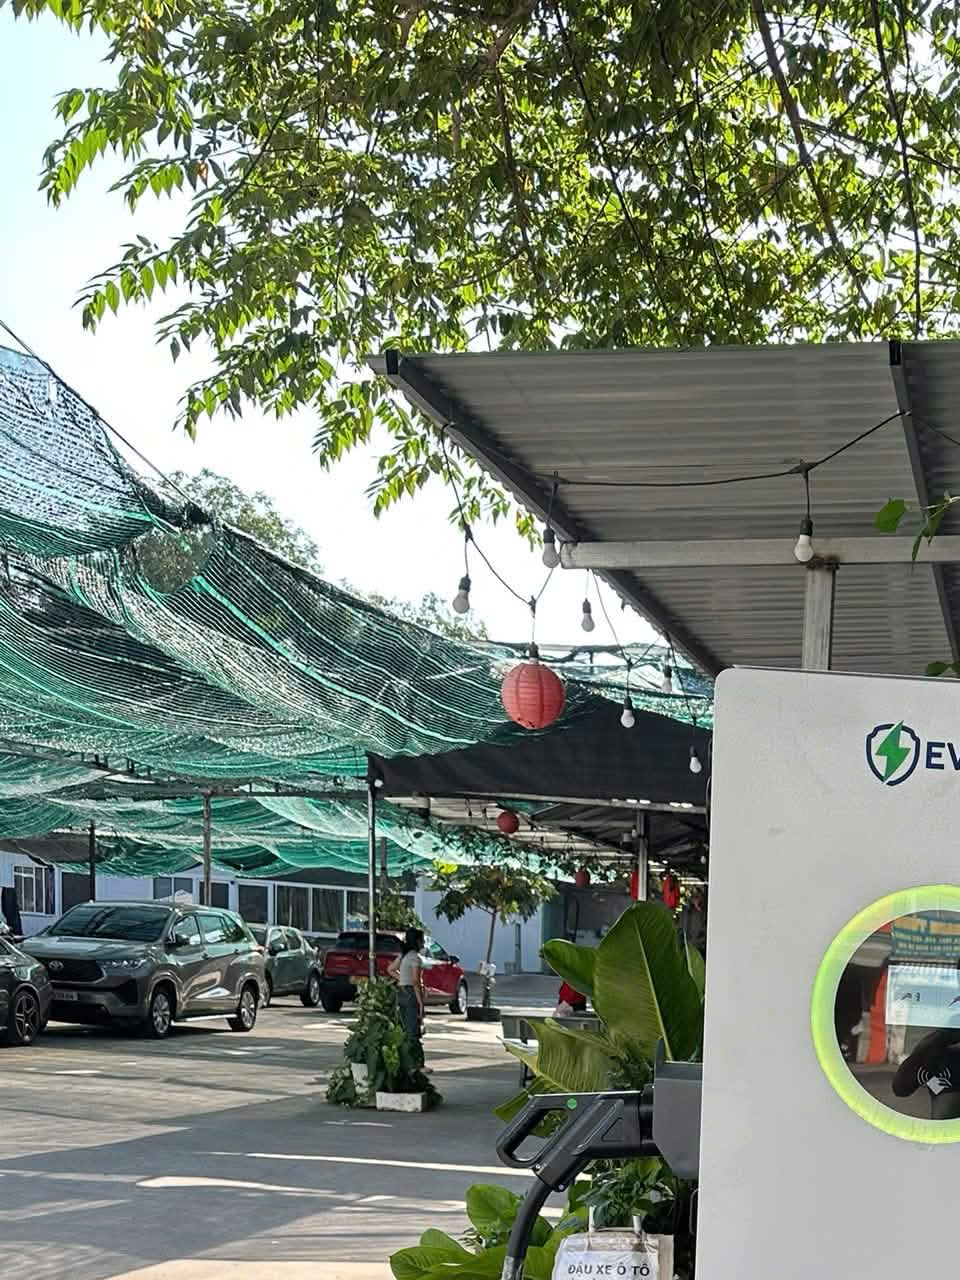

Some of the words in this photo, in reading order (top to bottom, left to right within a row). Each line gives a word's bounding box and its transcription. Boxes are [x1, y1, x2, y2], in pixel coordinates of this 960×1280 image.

[596, 1264, 613, 1275] XE
[616, 1262, 627, 1276] Ô
[631, 1263, 650, 1277] TÔ
